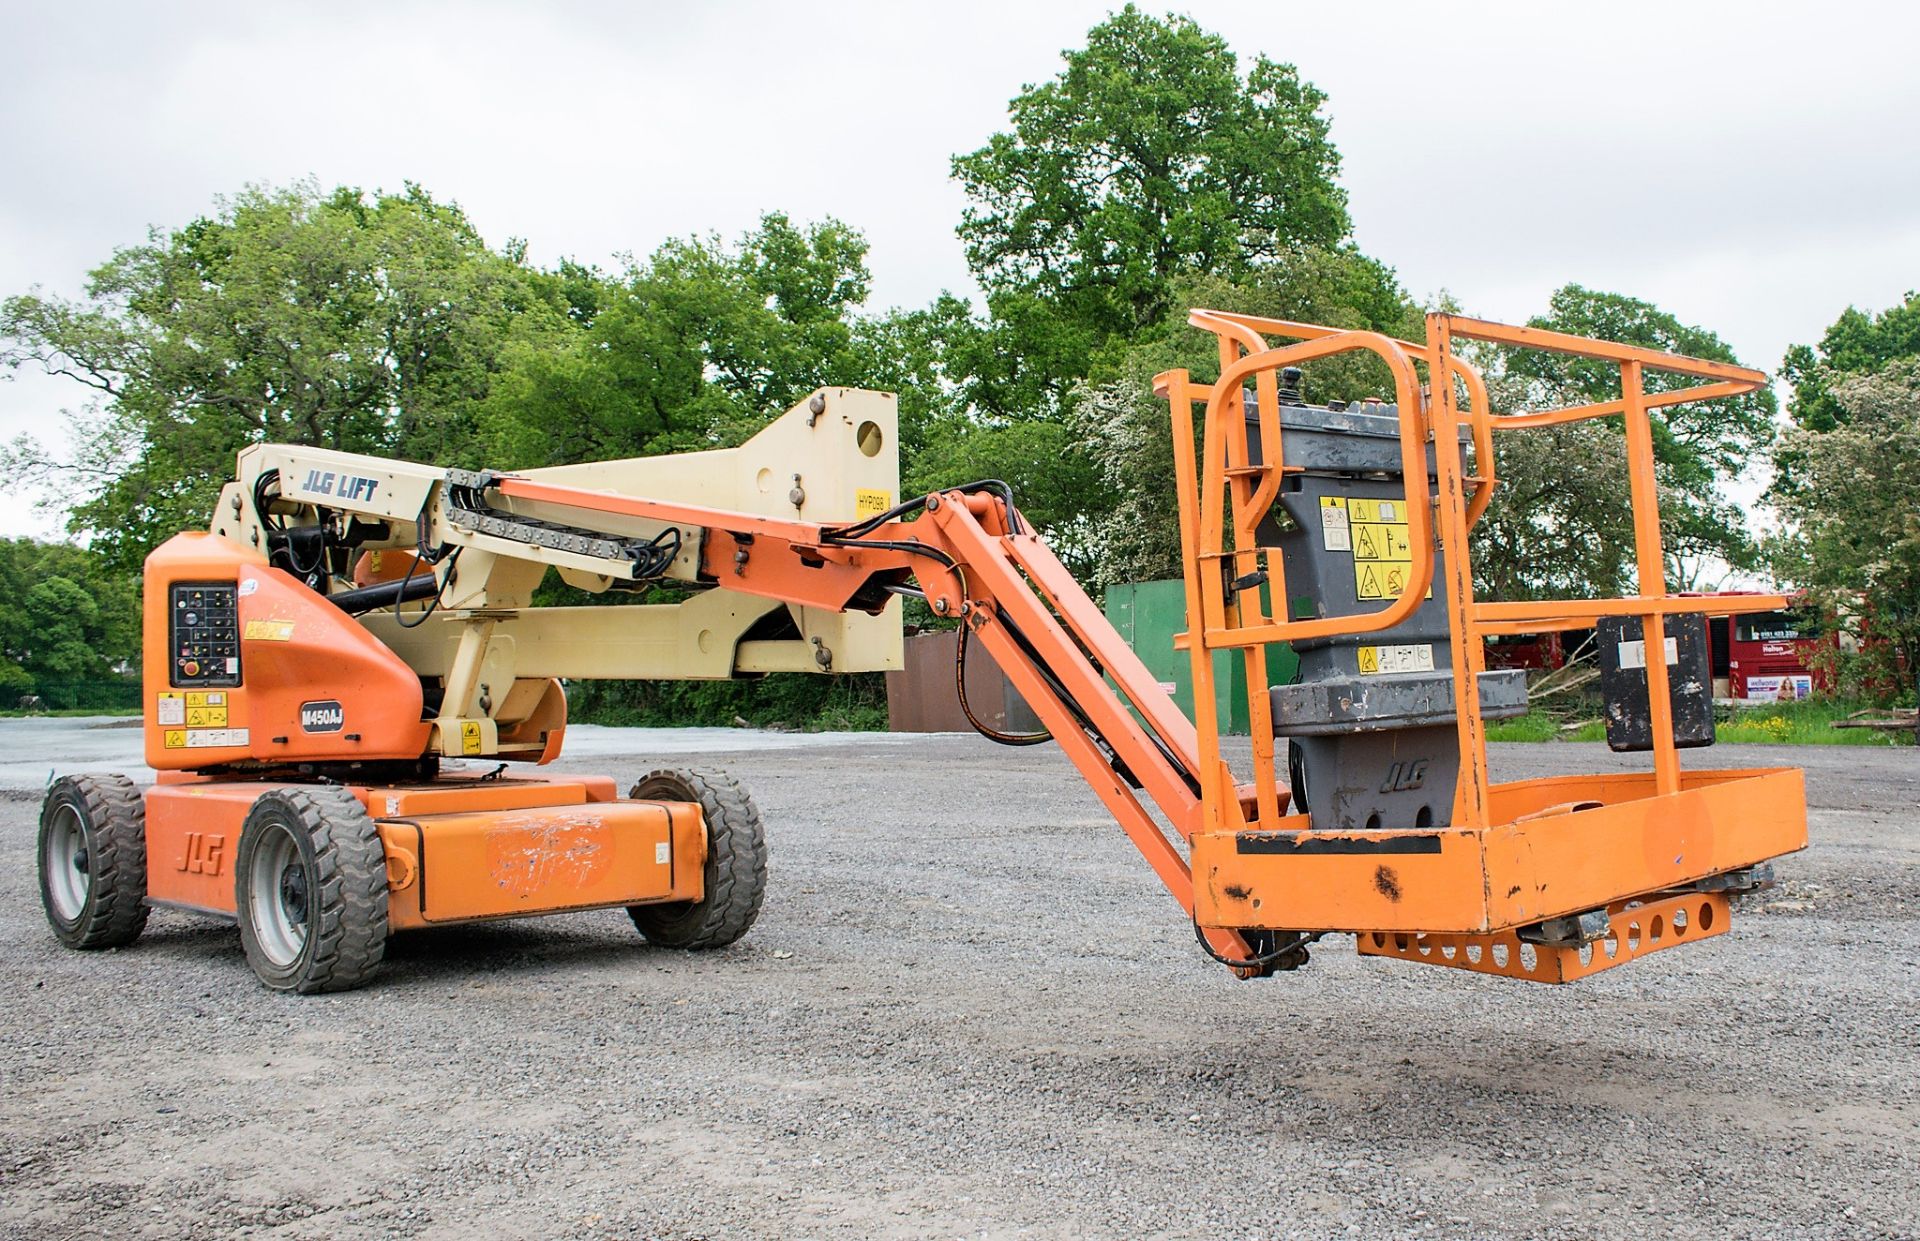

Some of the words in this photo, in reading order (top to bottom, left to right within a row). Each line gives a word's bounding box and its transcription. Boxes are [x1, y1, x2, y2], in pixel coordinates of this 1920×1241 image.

[302, 469, 336, 495] JLG
[337, 475, 379, 502] LIFT
[302, 708, 343, 726] M450AJ
[1379, 759, 1429, 794] JLG
[175, 831, 225, 877] JLG
